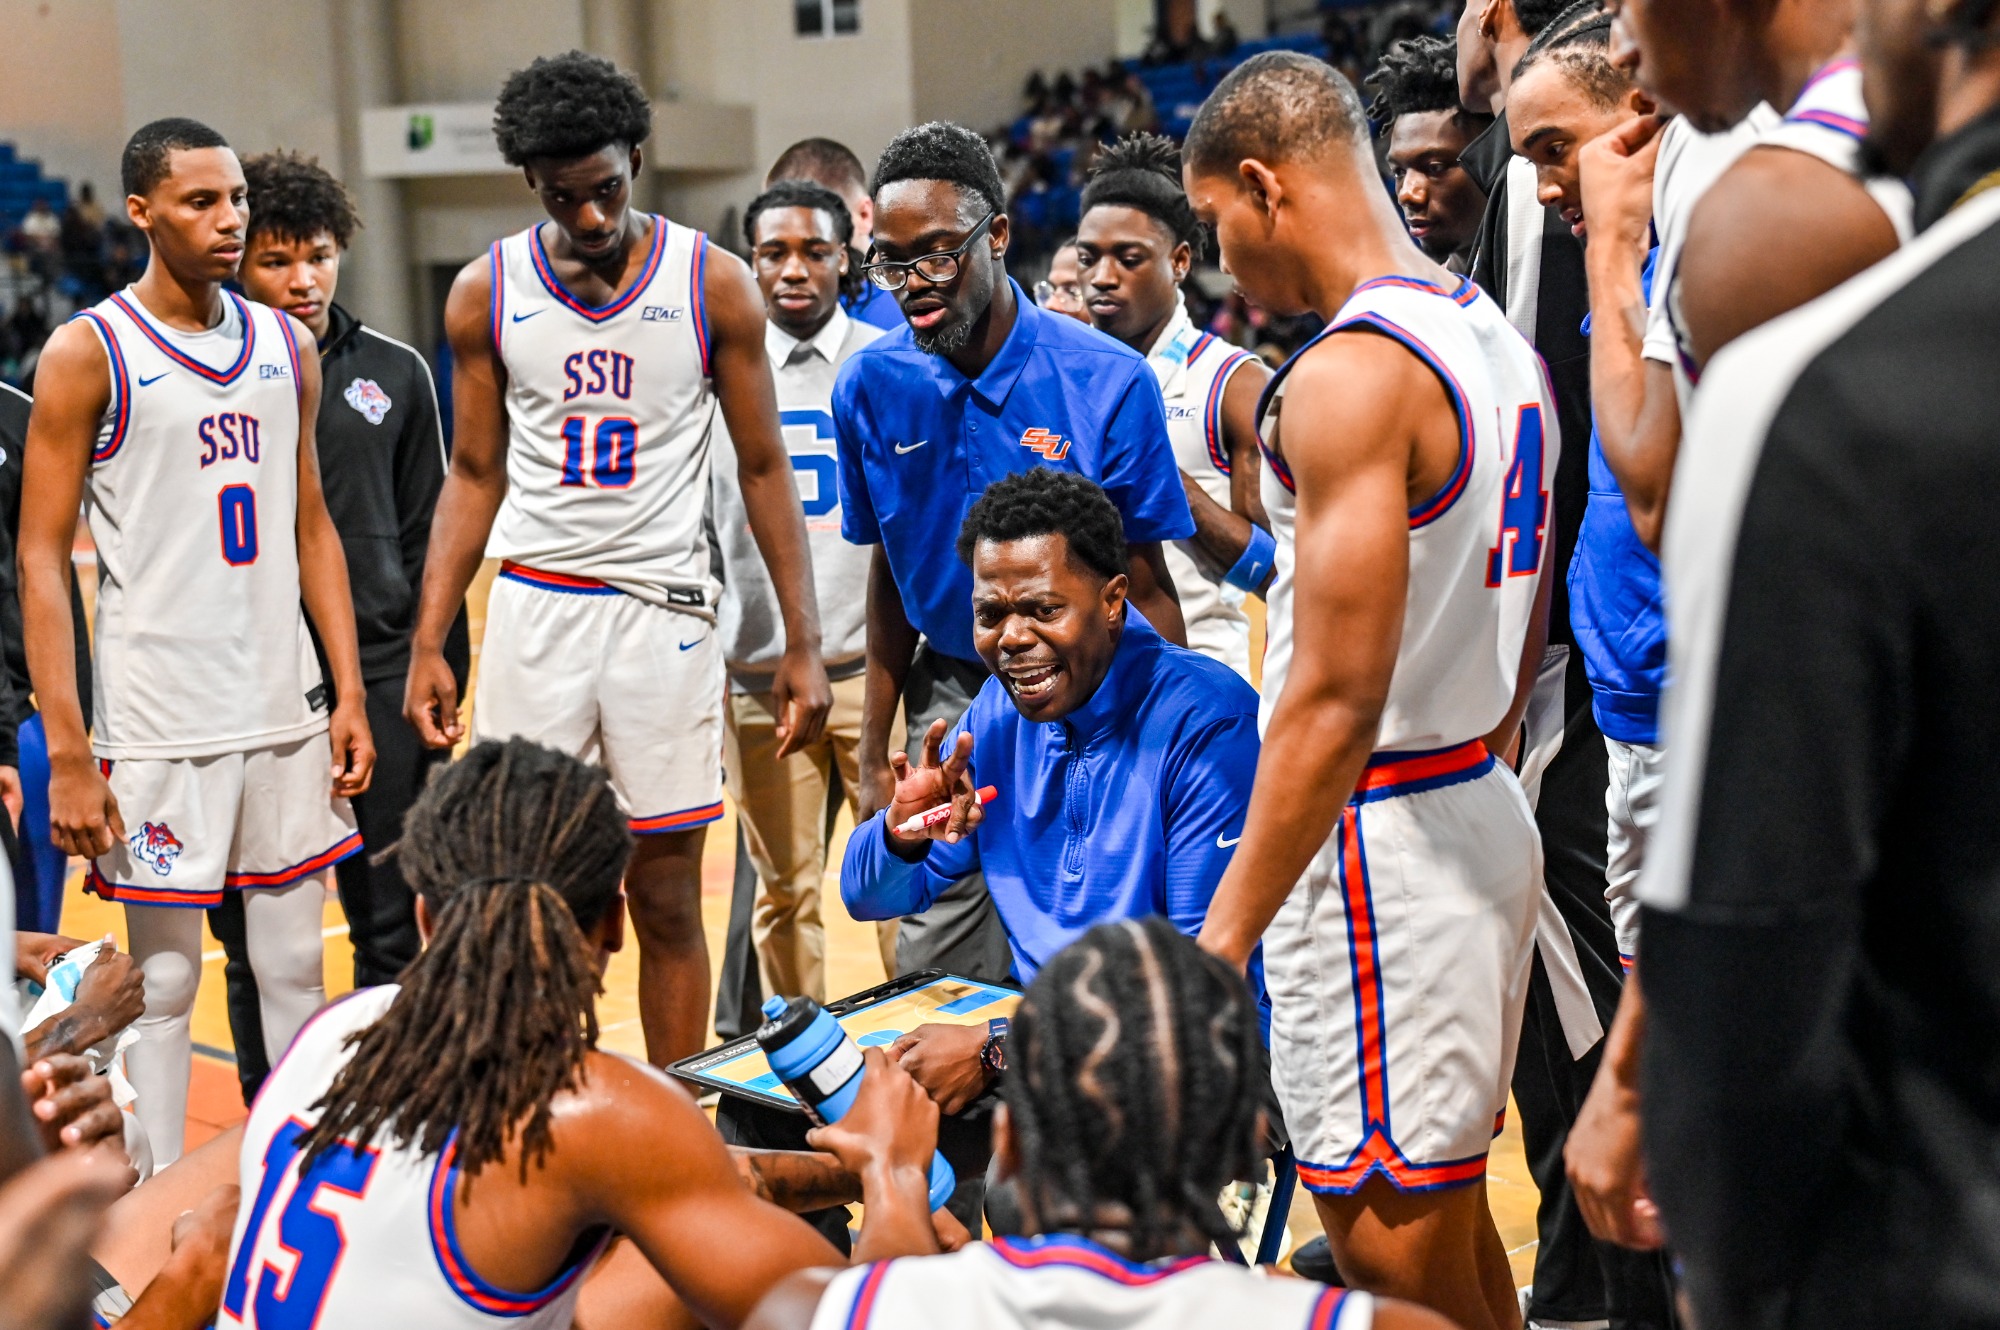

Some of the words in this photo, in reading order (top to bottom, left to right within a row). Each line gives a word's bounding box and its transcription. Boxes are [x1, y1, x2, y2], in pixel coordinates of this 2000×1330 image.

[563, 349, 635, 403] SSU
[198, 412, 260, 470] SSU
[560, 416, 639, 489] 10
[1020, 427, 1072, 460] SSU
[217, 483, 259, 567] 0
[222, 1114, 383, 1330] 15
